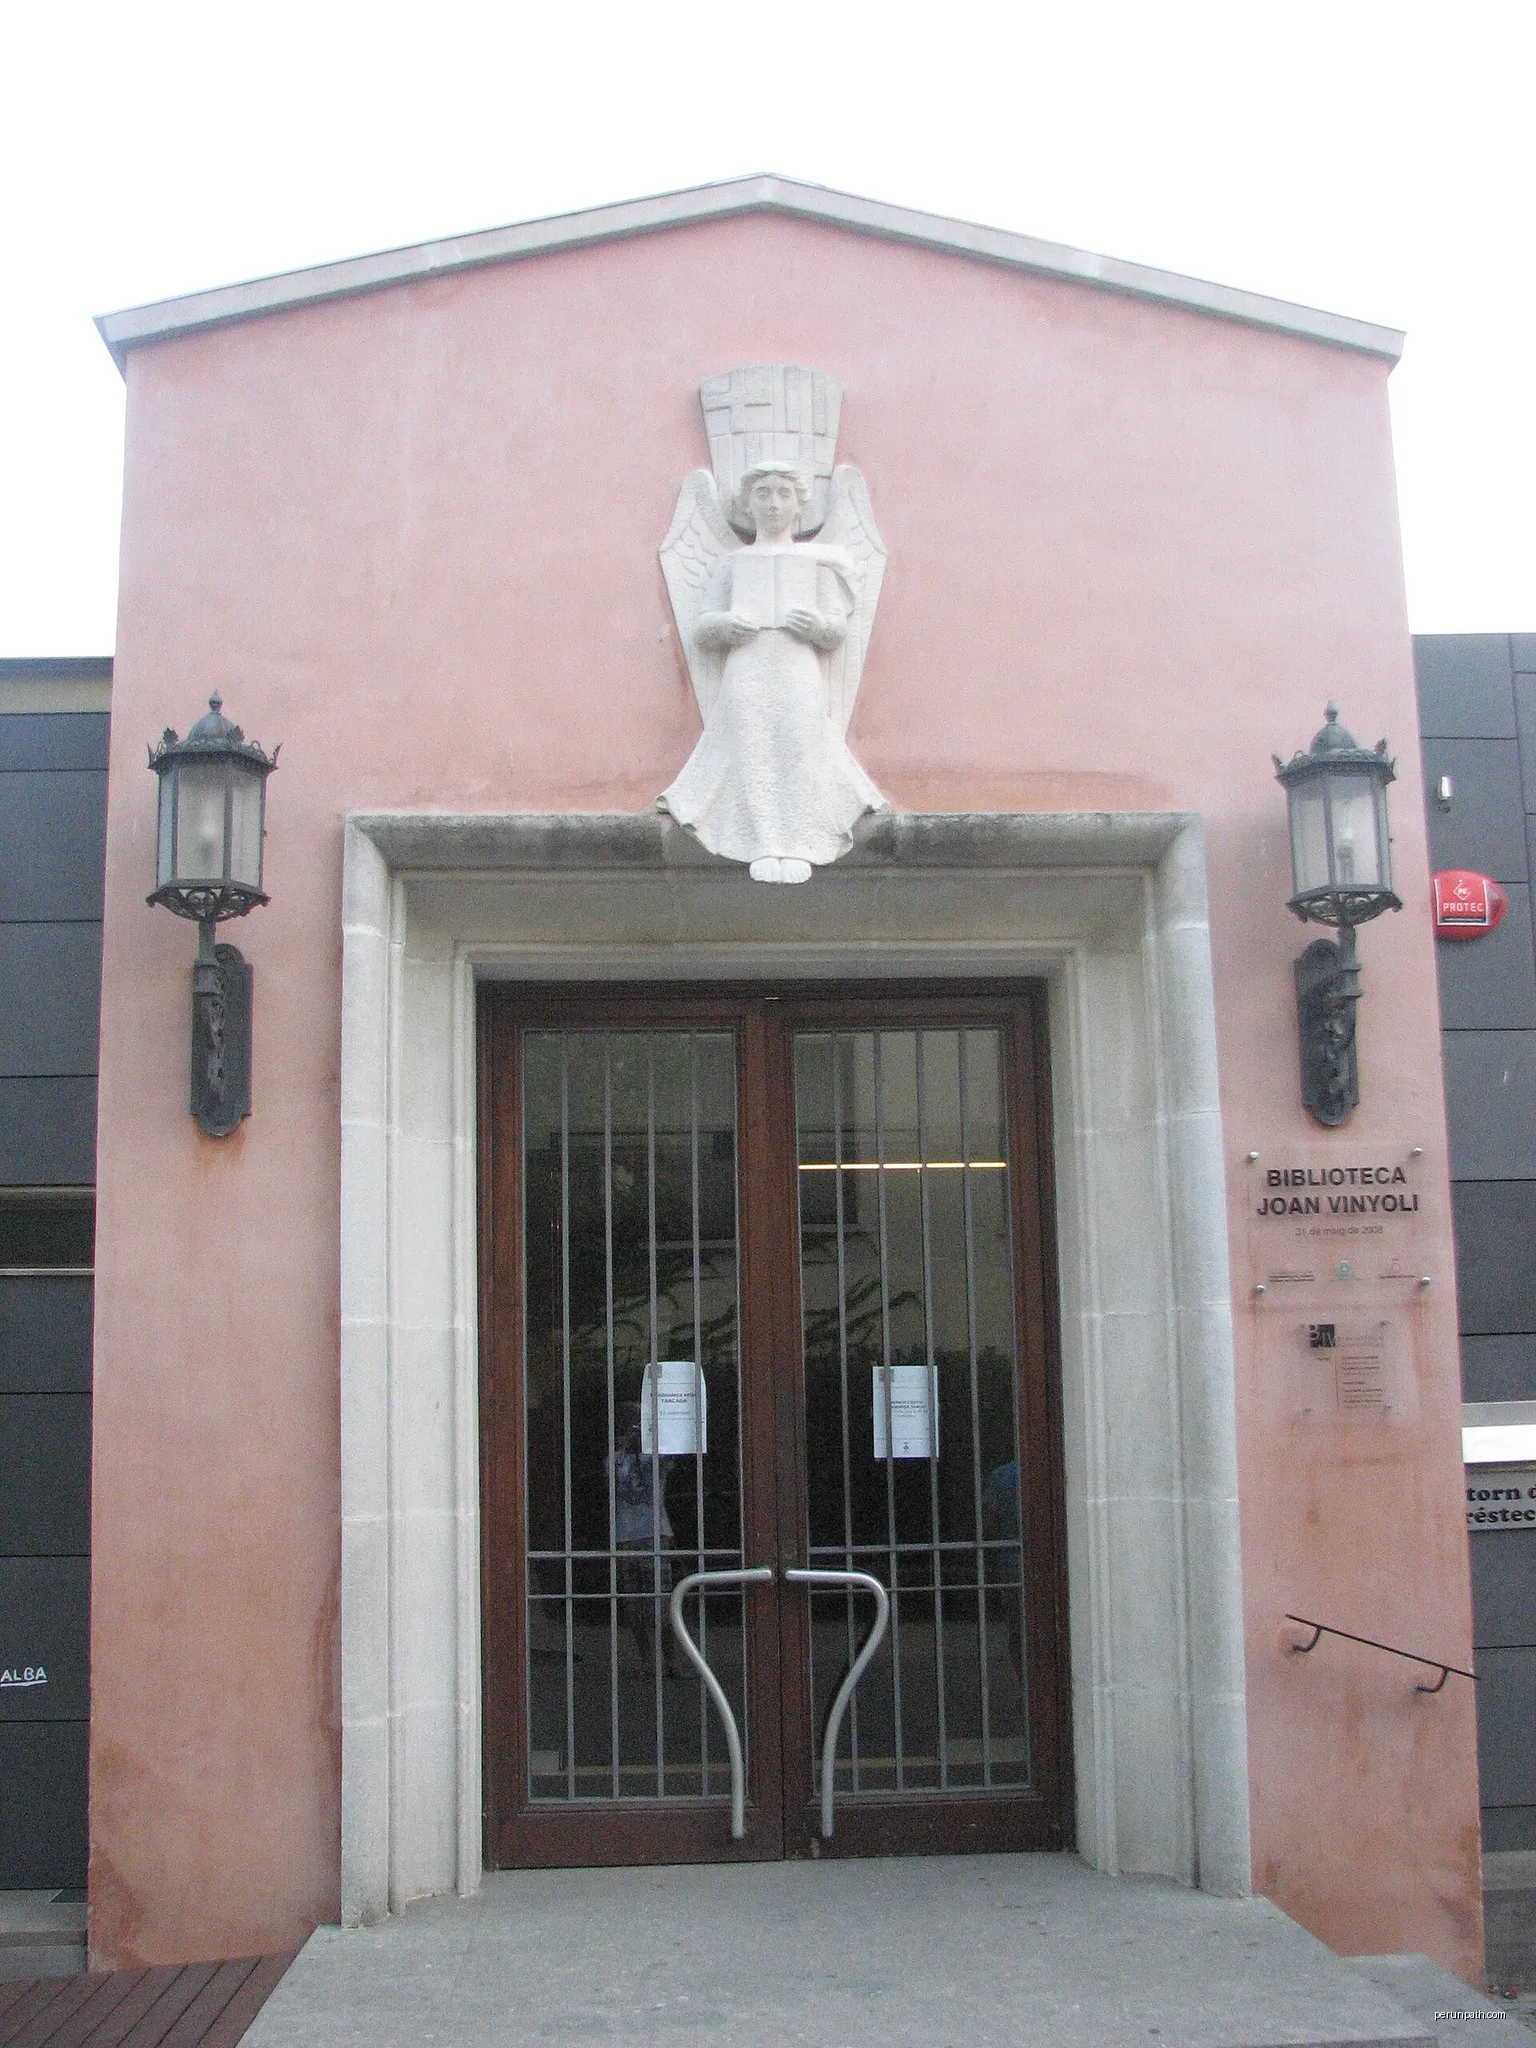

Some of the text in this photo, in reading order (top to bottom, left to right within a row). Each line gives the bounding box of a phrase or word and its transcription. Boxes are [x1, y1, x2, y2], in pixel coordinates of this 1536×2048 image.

[1443, 902, 1483, 912] PROTEC
[1266, 1166, 1407, 1187] BIBLIOTECA
[1256, 1194, 1419, 1216] JOAN VINYOLI
[1309, 1226, 1320, 1236] de
[1466, 1487, 1522, 1501] torn
[0, 1666, 47, 1682] ALBA
